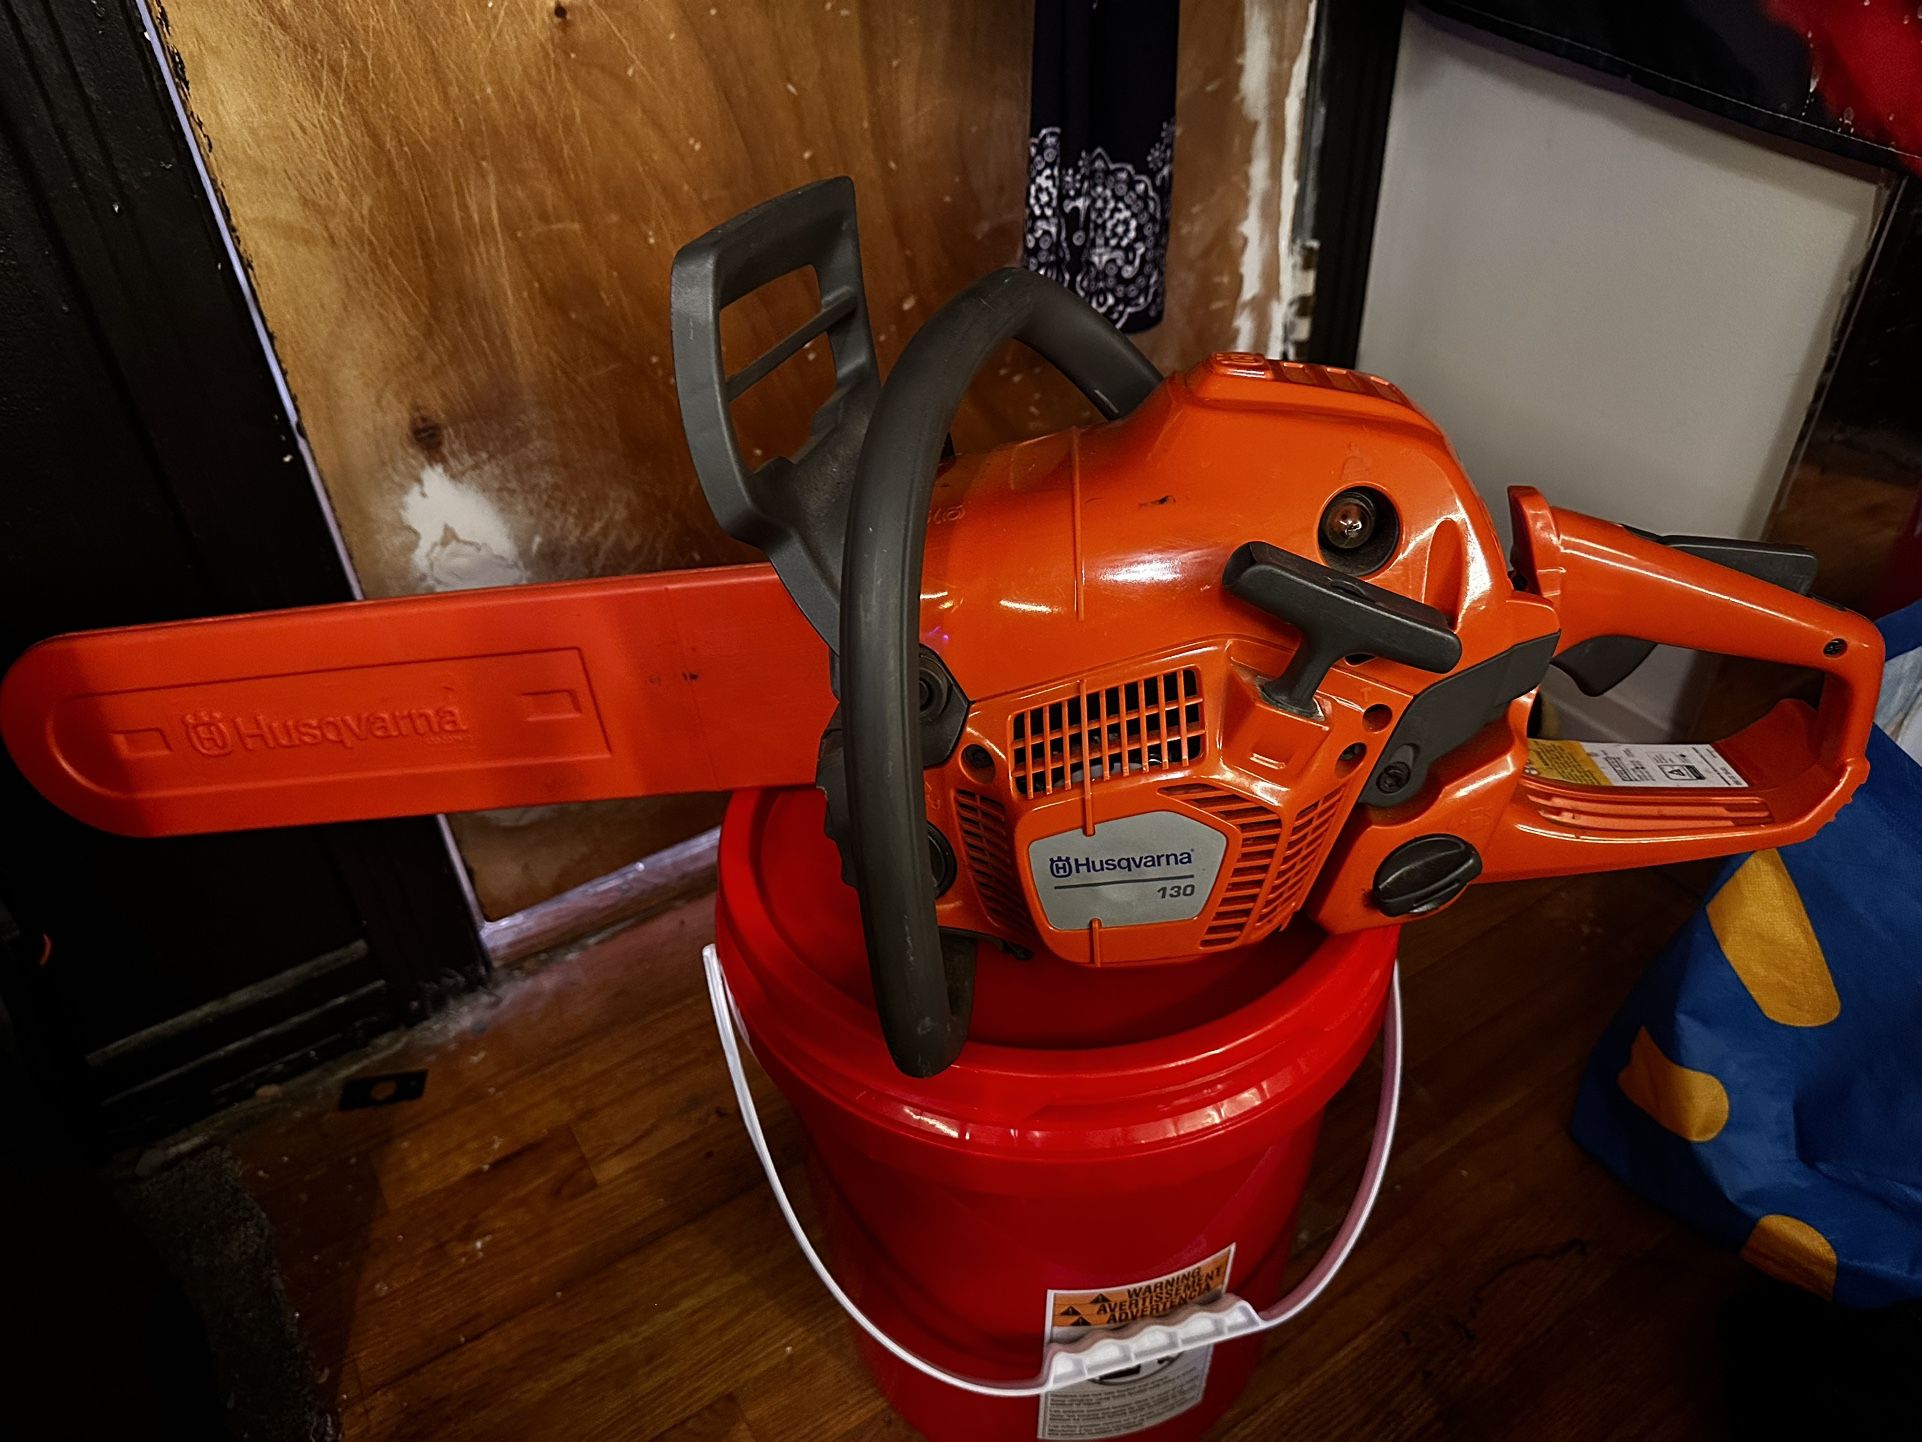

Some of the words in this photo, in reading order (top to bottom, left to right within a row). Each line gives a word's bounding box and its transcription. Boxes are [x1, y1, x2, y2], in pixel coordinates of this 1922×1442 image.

[233, 704, 467, 751] Husqvarna
[1074, 851, 1193, 873] Husqvarna
[1157, 884, 1196, 899] 130
[1097, 1265, 1223, 1315] AVERTISSEMENT
[1127, 1266, 1201, 1298] WARNING
[1107, 1283, 1212, 1324] ADVERTENCIA
